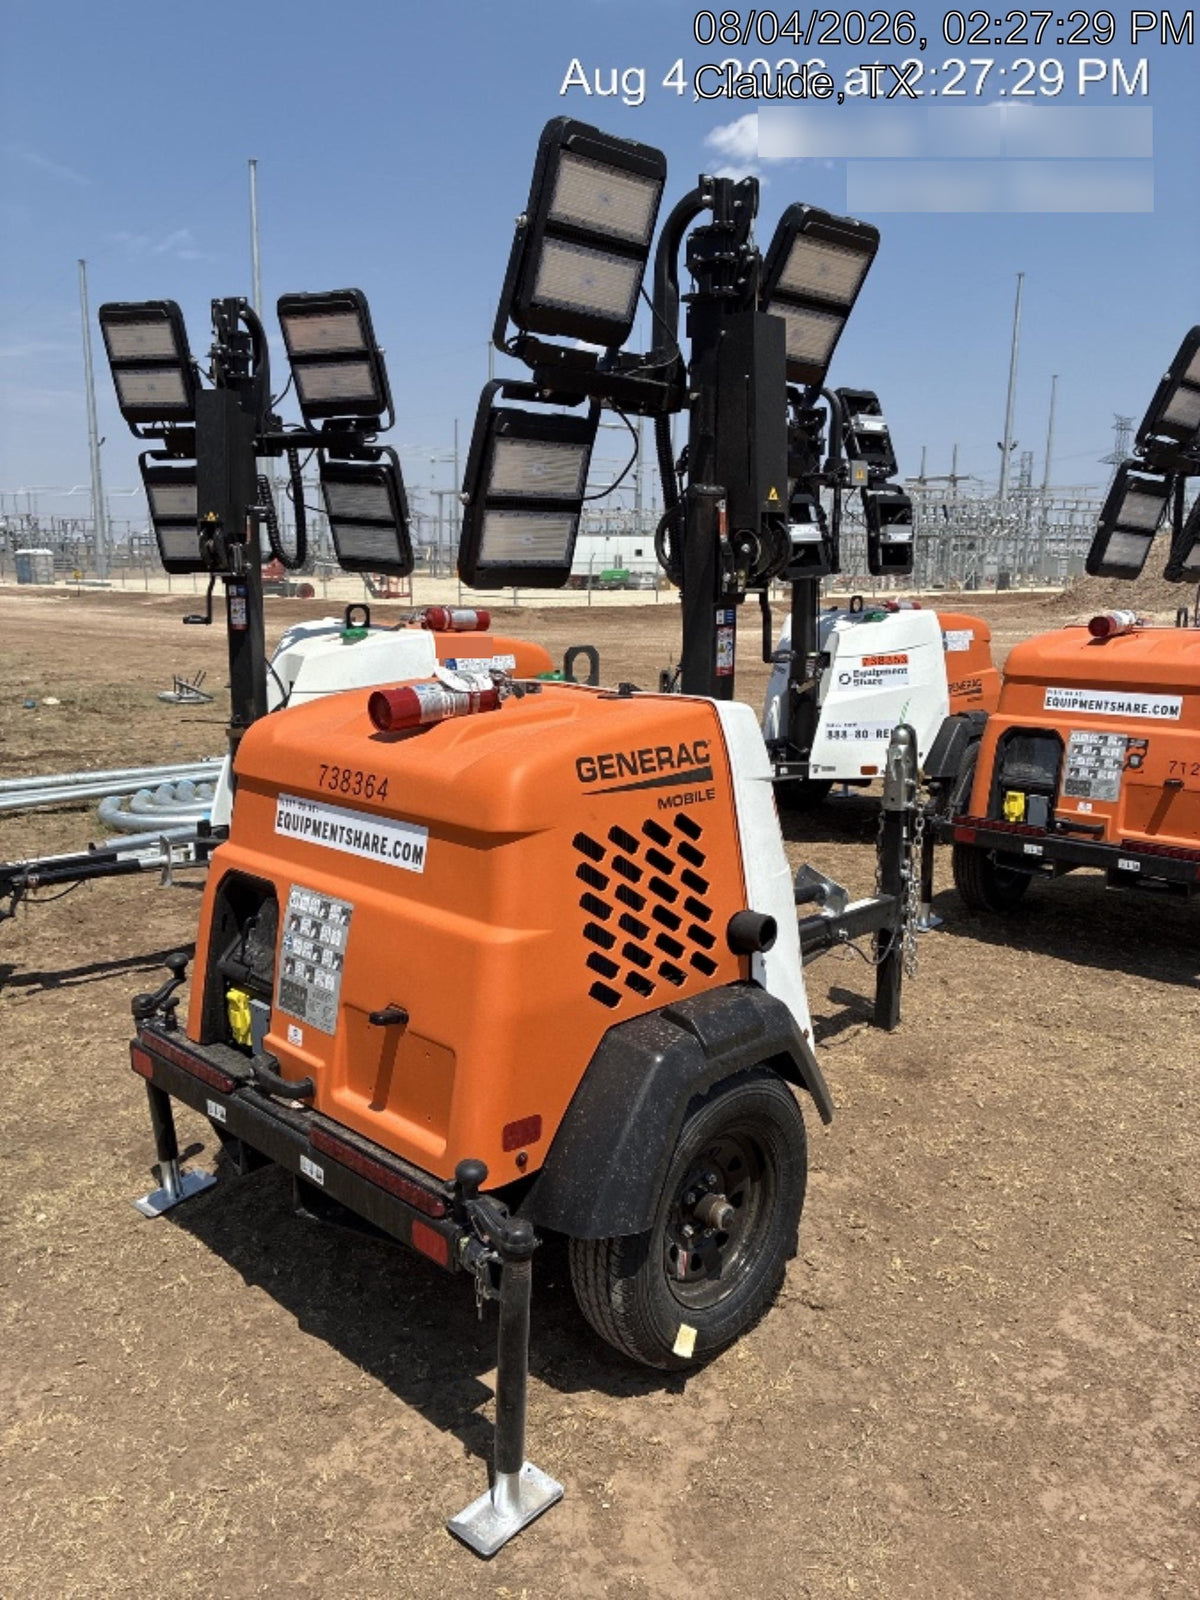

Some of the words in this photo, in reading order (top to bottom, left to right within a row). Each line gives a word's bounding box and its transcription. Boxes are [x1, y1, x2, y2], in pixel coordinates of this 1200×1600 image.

[853, 668, 908, 678] Equipment
[853, 678, 883, 687] Share
[1045, 696, 1179, 716] EQUIPMENTSHARE.COM
[575, 740, 711, 783] GENERAC
[318, 764, 389, 801] 738364
[657, 788, 716, 810] MOBILE
[276, 810, 424, 866] EQUIPMENTSHARE.COM
